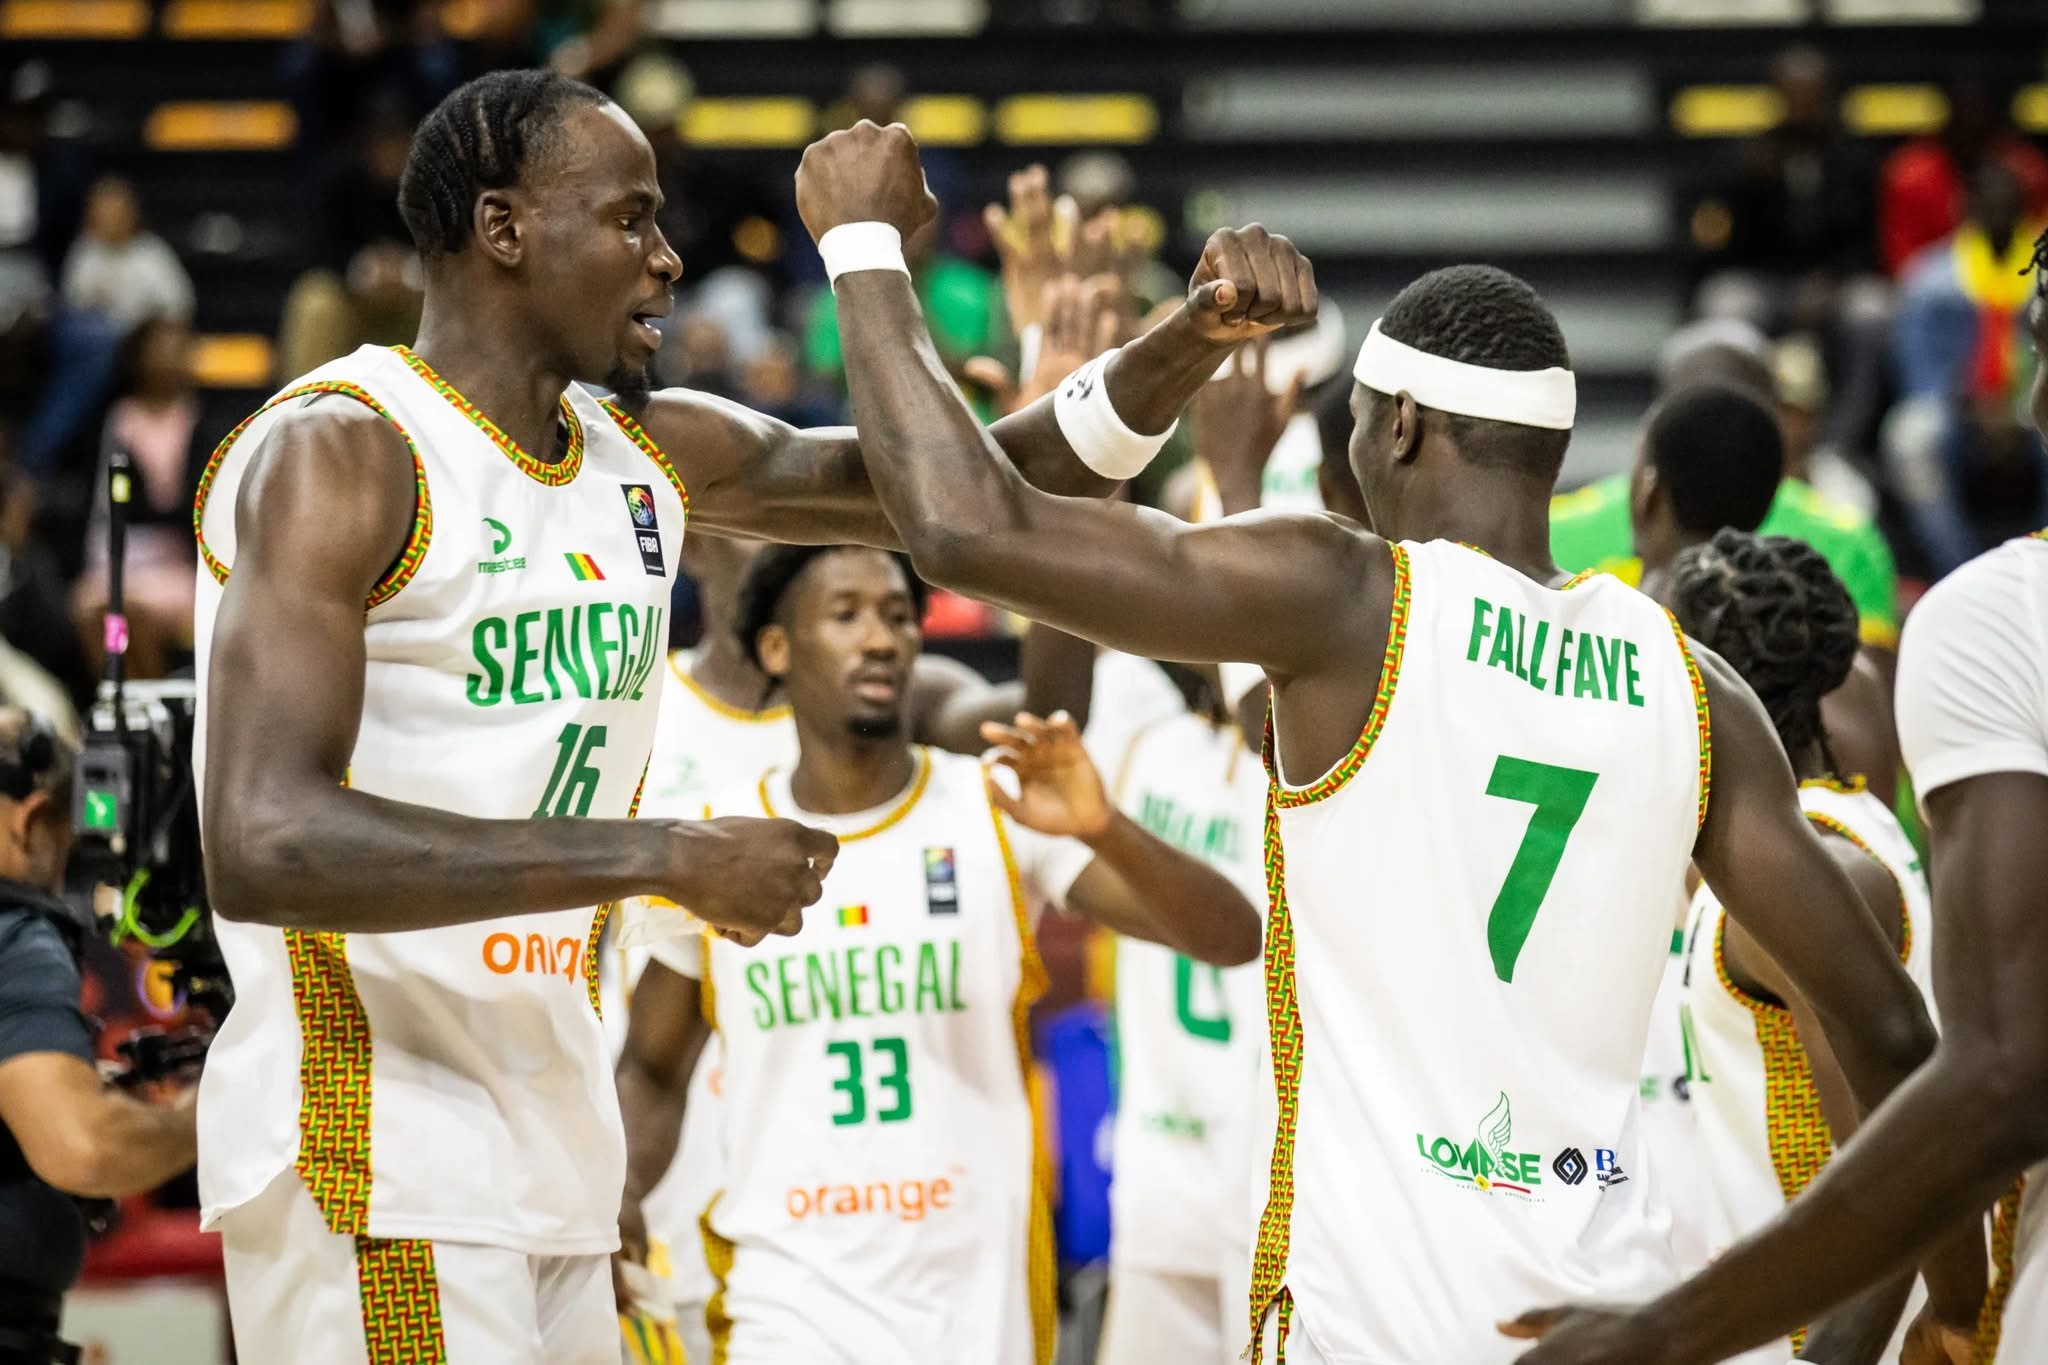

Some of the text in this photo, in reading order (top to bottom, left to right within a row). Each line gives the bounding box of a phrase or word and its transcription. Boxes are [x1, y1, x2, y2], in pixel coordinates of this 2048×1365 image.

[640, 537, 659, 553] FIBA
[466, 602, 663, 707] SENEGAL
[1466, 597, 1645, 708] FALL FAYE
[530, 722, 608, 818] 16
[1485, 755, 1600, 983] 7
[745, 941, 970, 1030] SENEGAL
[826, 1037, 912, 1126] 33
[786, 1177, 953, 1222] orange
